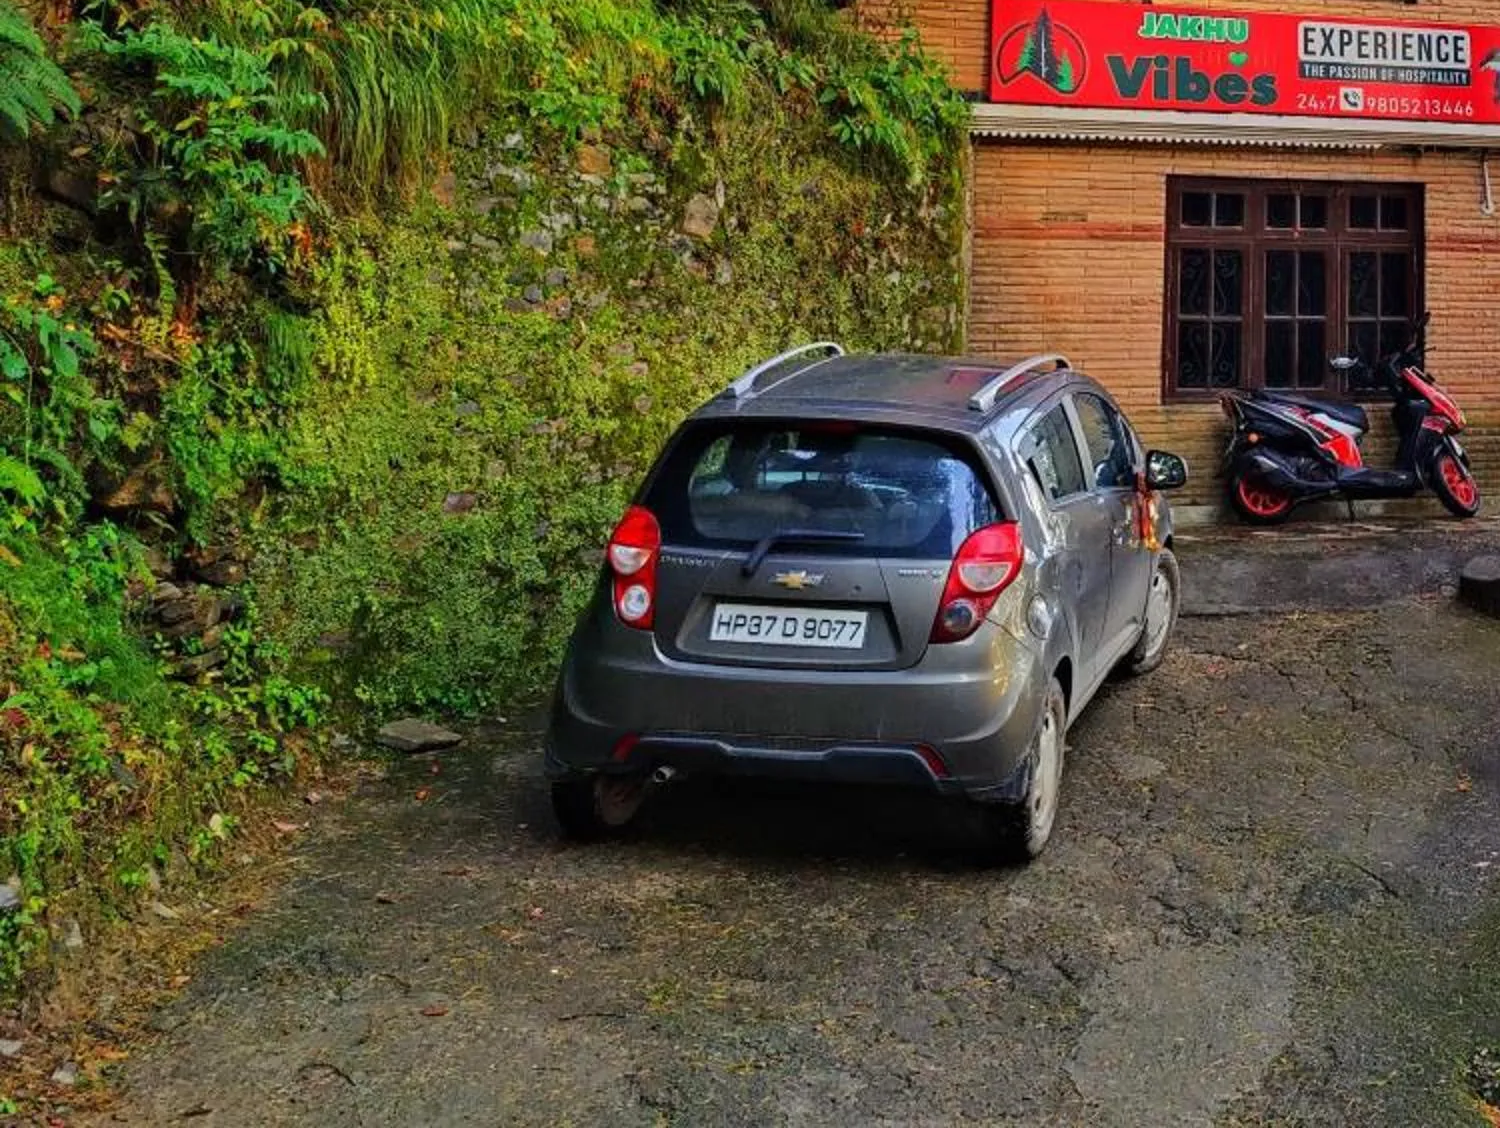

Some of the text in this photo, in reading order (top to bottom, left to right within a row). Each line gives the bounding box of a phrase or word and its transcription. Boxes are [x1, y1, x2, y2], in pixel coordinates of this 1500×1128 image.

[1138, 12, 1249, 43] JAKHU
[1302, 26, 1467, 64] EXPERIENCE
[1105, 53, 1279, 106] Vibes
[1304, 63, 1467, 85] THE PASSION OF HOSPITALITY
[1367, 97, 1473, 117] 9805213446
